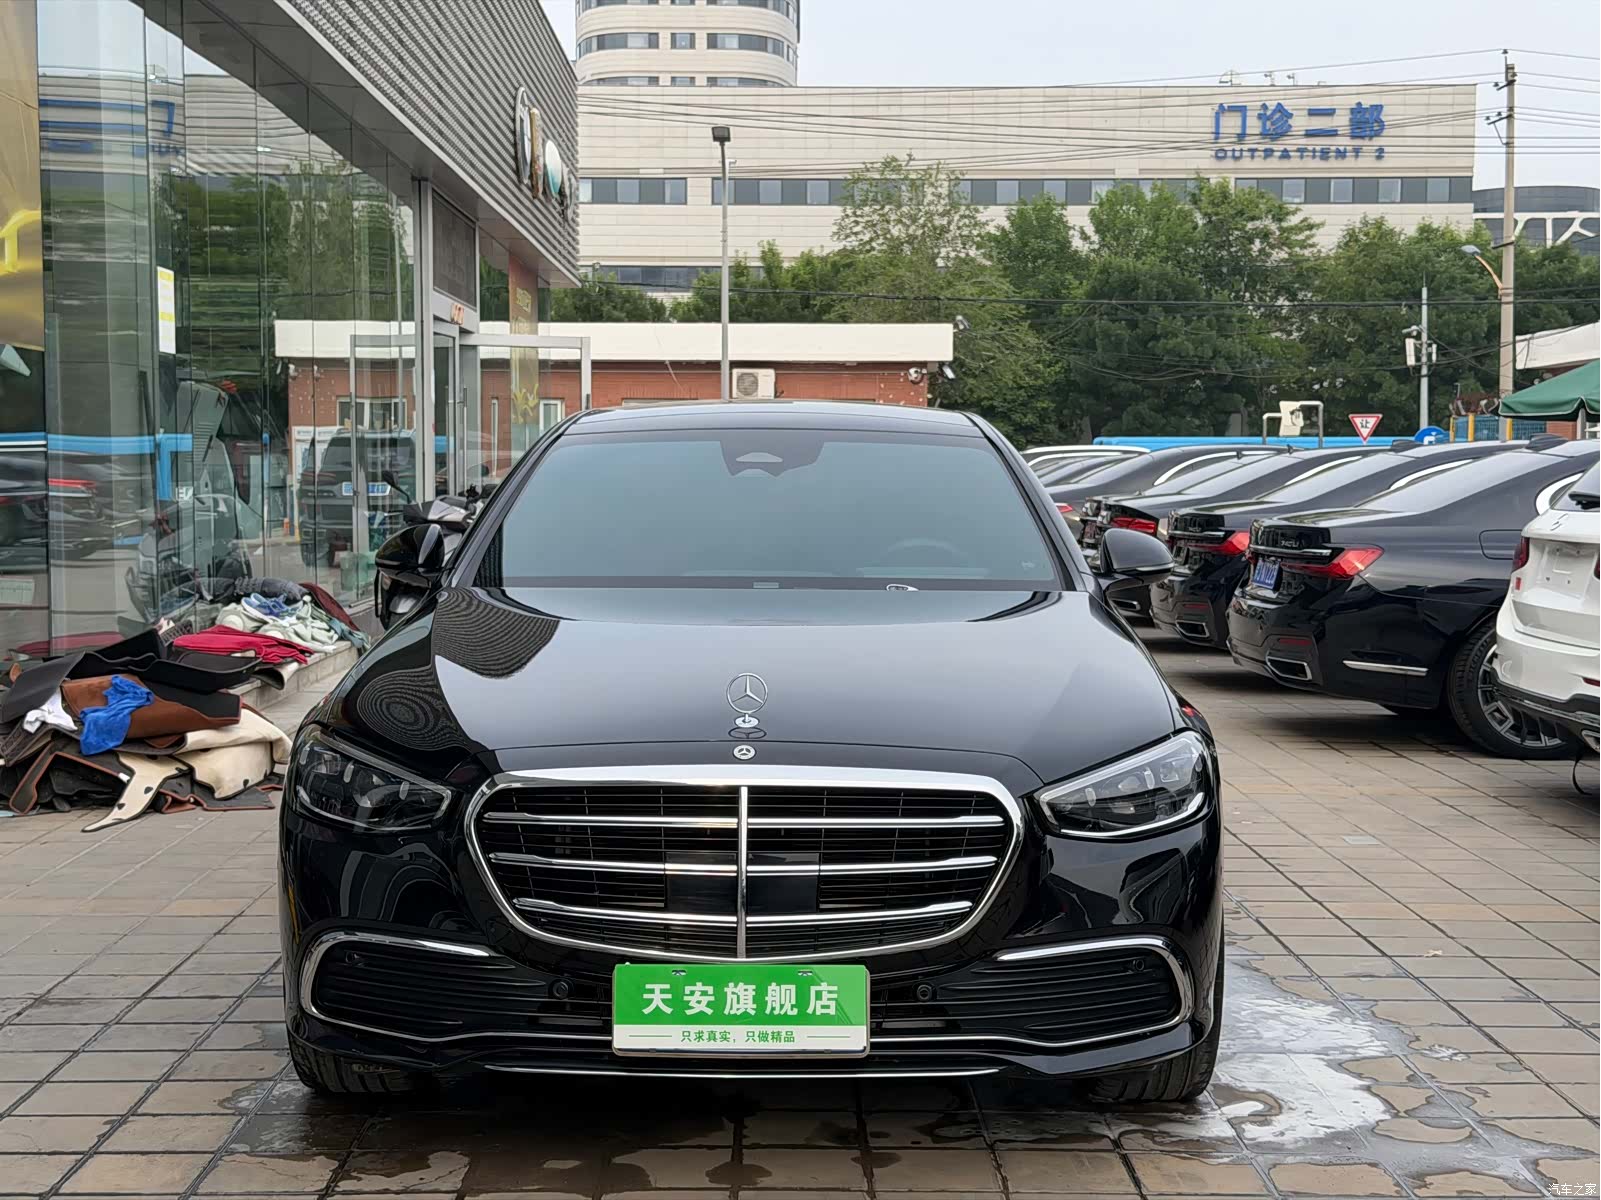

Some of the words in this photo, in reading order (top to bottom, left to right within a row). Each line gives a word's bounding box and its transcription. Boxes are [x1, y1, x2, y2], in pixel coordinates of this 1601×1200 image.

[1214, 101, 1385, 141] 门诊二部
[1214, 147, 1363, 161] OUTPATIENT
[1374, 147, 1386, 160] 2
[1359, 419, 1370, 429] 让
[641, 981, 839, 1016] 天安旗舰店
[680, 1030, 796, 1044] 只求真实，只做精品
